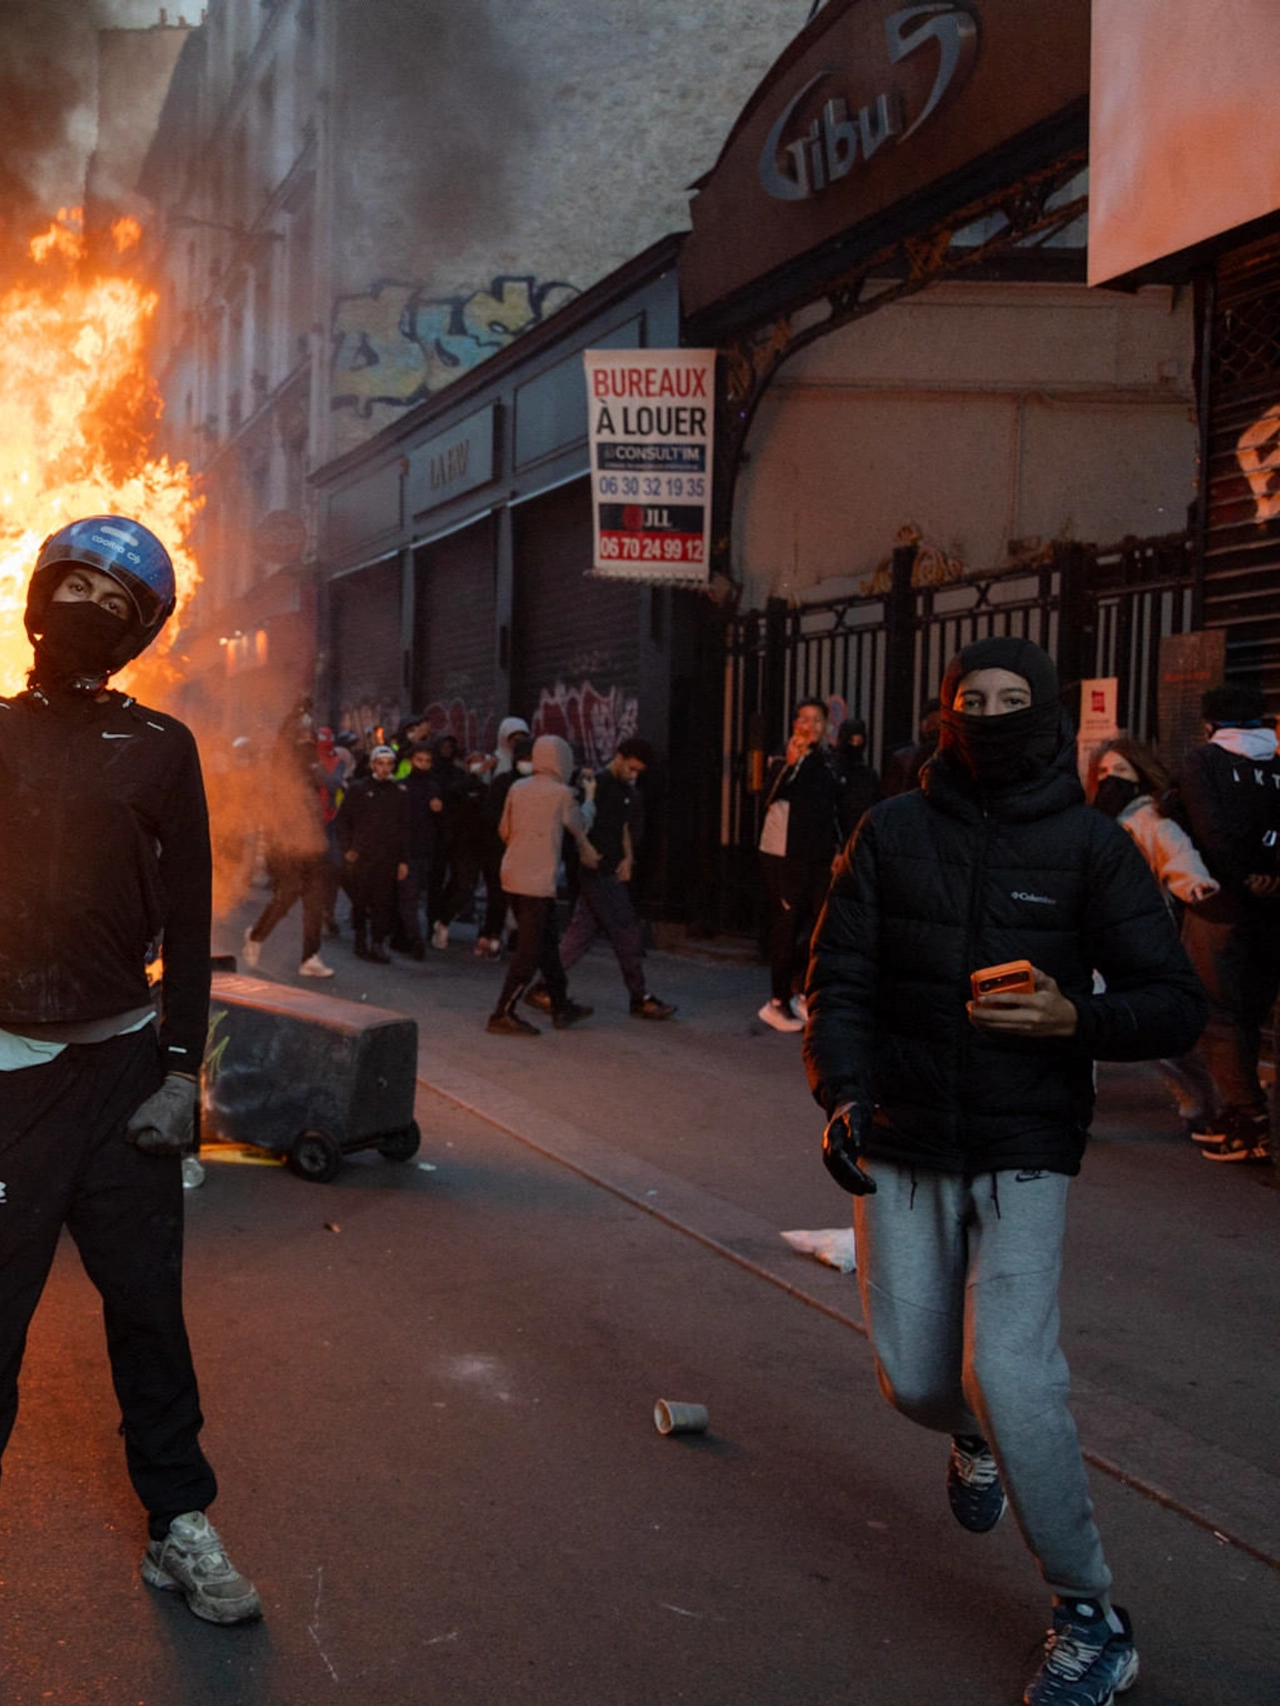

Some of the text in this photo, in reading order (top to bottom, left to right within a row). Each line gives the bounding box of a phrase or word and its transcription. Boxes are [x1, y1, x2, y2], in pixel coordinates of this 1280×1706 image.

[593, 368, 707, 398] BUREAUX
[596, 399, 707, 436] À LOUER
[616, 446, 700, 461] CONSULT'IM
[599, 476, 705, 497] 06 30 32 19 35
[644, 509, 672, 528] JLL
[601, 537, 703, 560] 06 70 24 99 12
